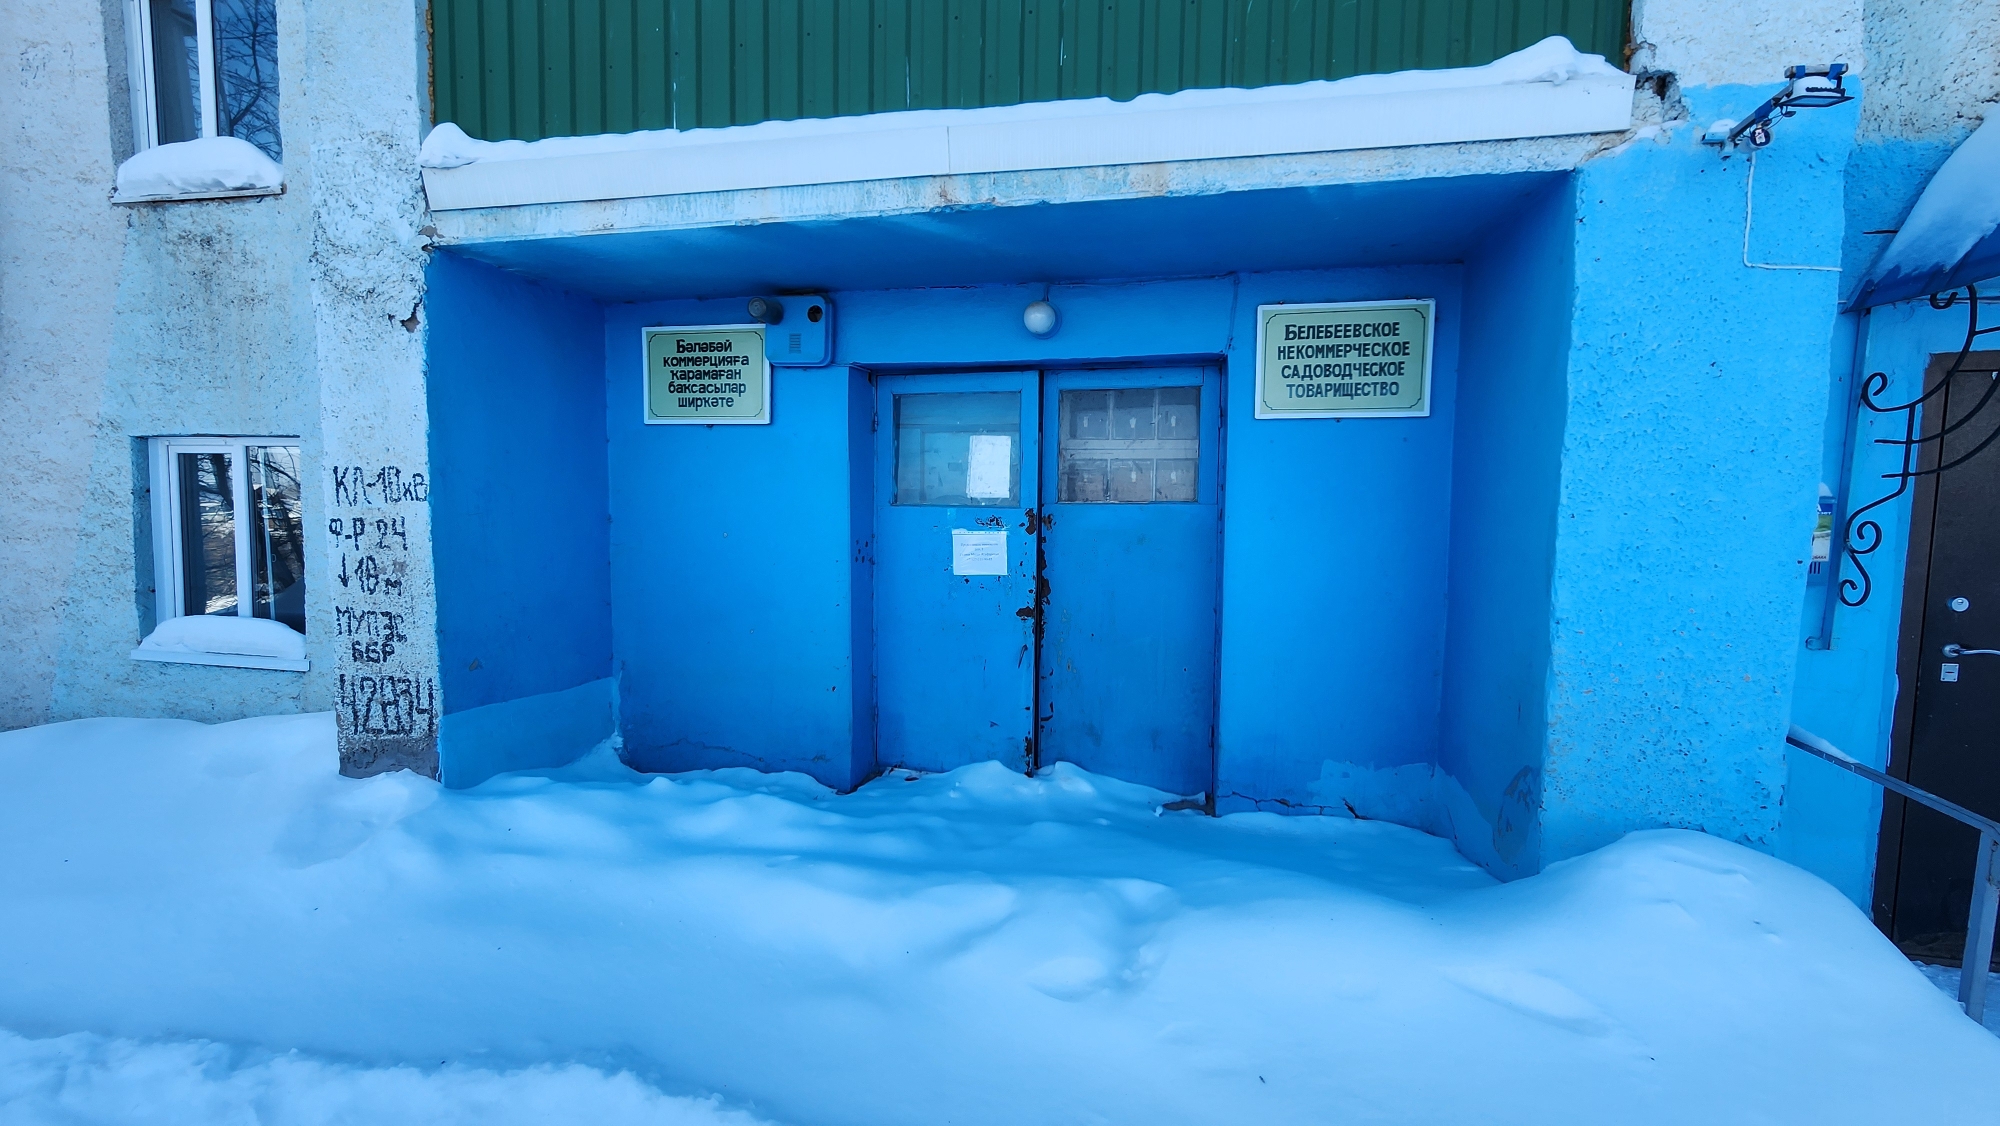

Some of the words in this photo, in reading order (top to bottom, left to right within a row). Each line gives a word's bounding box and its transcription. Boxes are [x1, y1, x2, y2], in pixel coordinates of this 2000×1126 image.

[1284, 322, 1400, 341] БЕЛЕБЕЕВСКОЕ
[1277, 341, 1410, 361] НЕКОММЕРЧЕСКОЕ
[1281, 361, 1405, 381] САДОВОДЧЕСКОЕ
[1286, 381, 1400, 400] ТОВАРИЩЕСТВО
[678, 397, 734, 411] ширкәте
